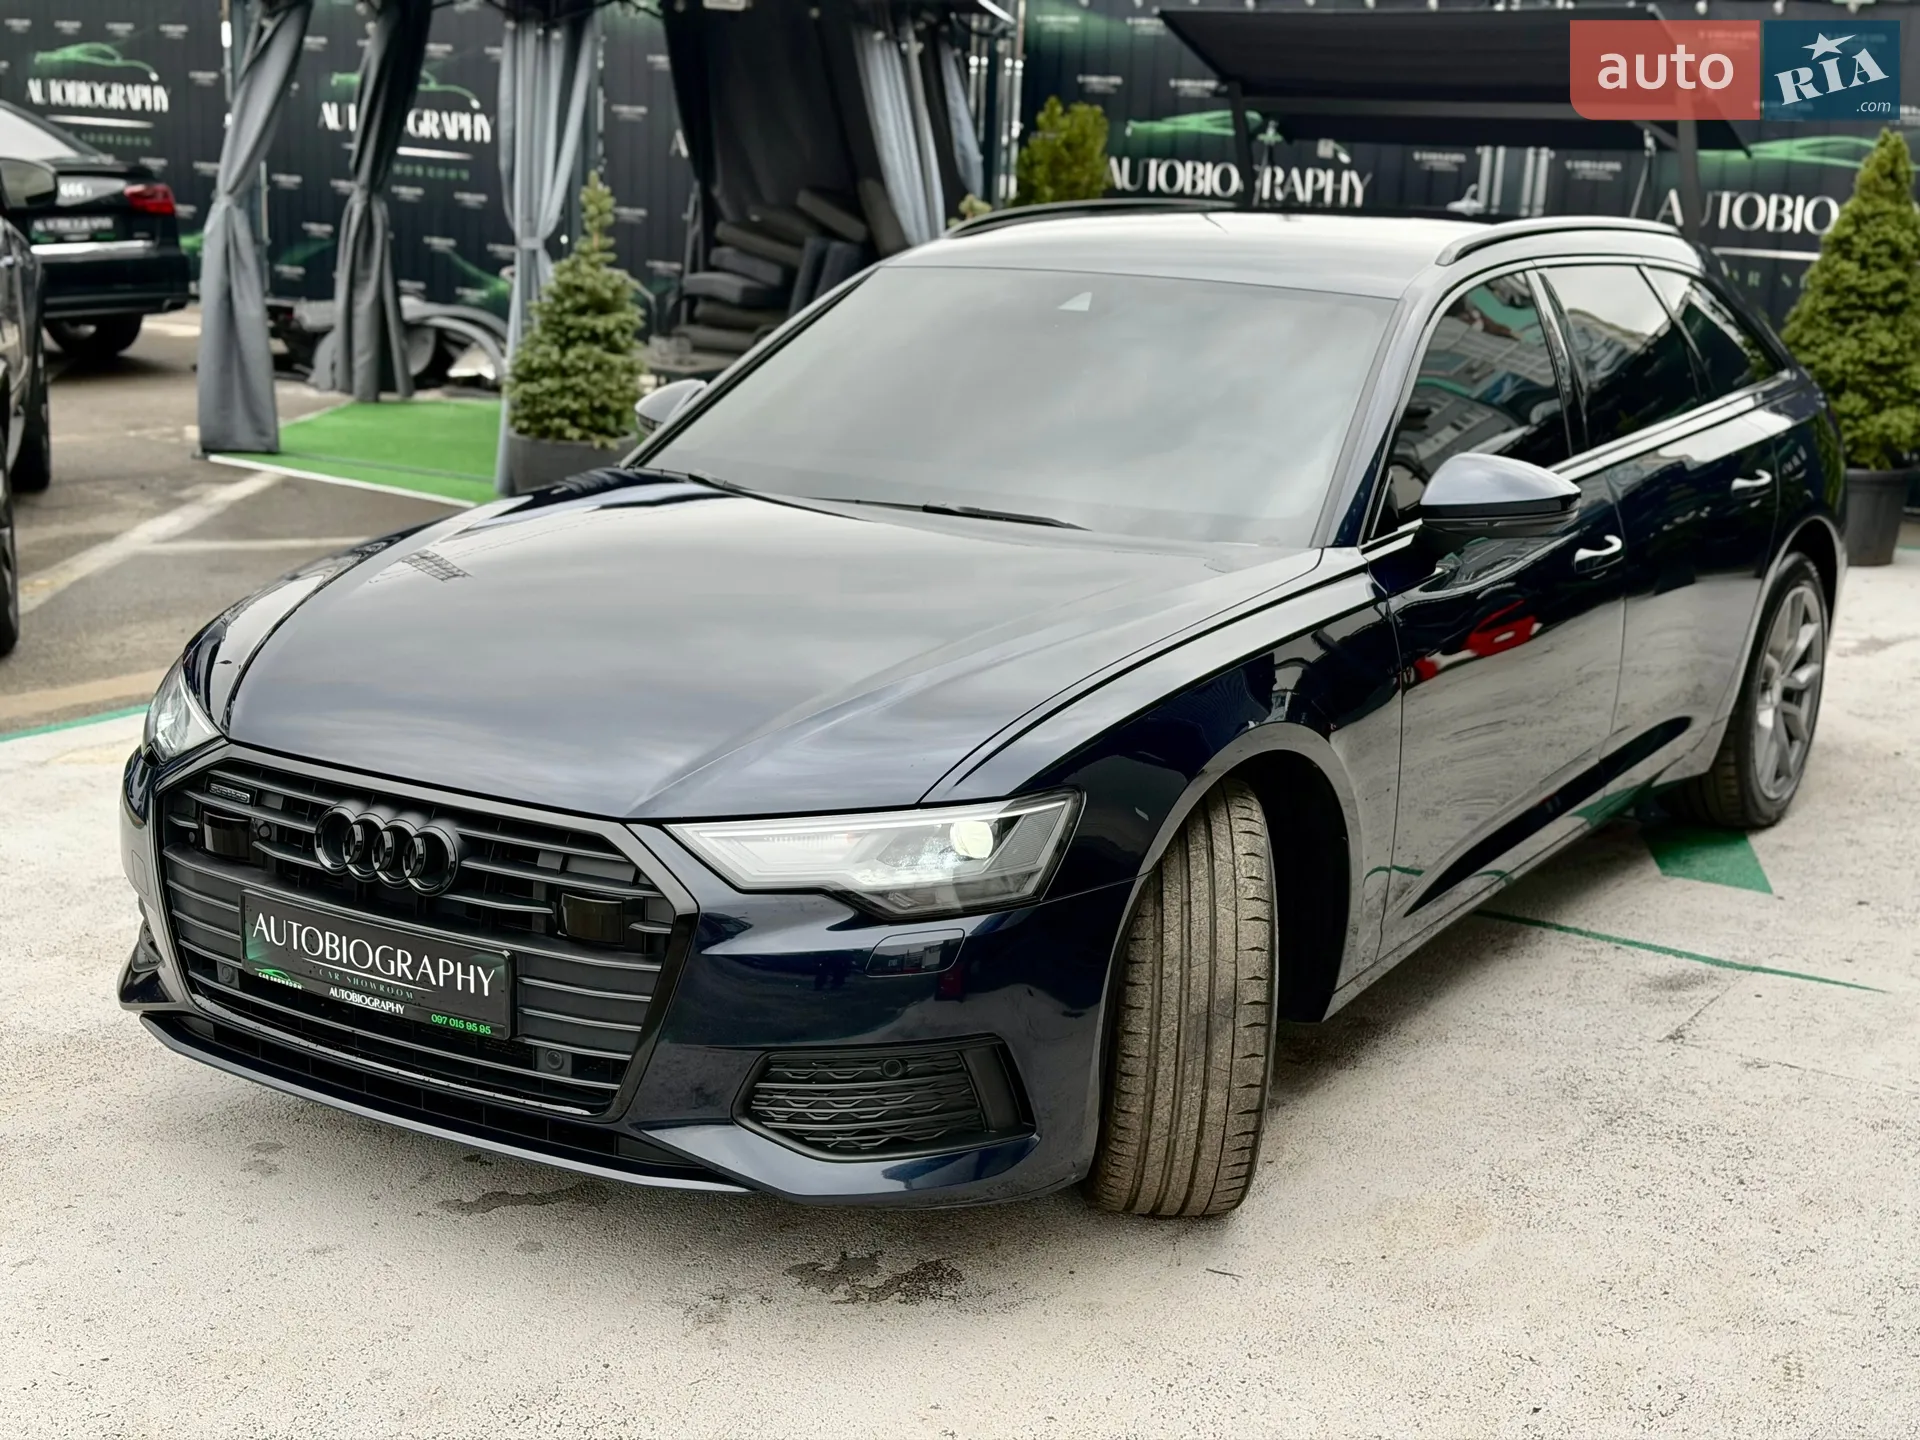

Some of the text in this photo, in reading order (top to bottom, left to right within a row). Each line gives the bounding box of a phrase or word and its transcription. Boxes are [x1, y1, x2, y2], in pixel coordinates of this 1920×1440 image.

[1106, 155, 1372, 208] AUTOBIORAPHY
[252, 912, 495, 997] AUTOBIOGRAPHY
[319, 967, 340, 981] CAR
[329, 987, 405, 1015] AUTOBIOGRAPHY
[431, 1014, 492, 1035] 097 015 95 95
